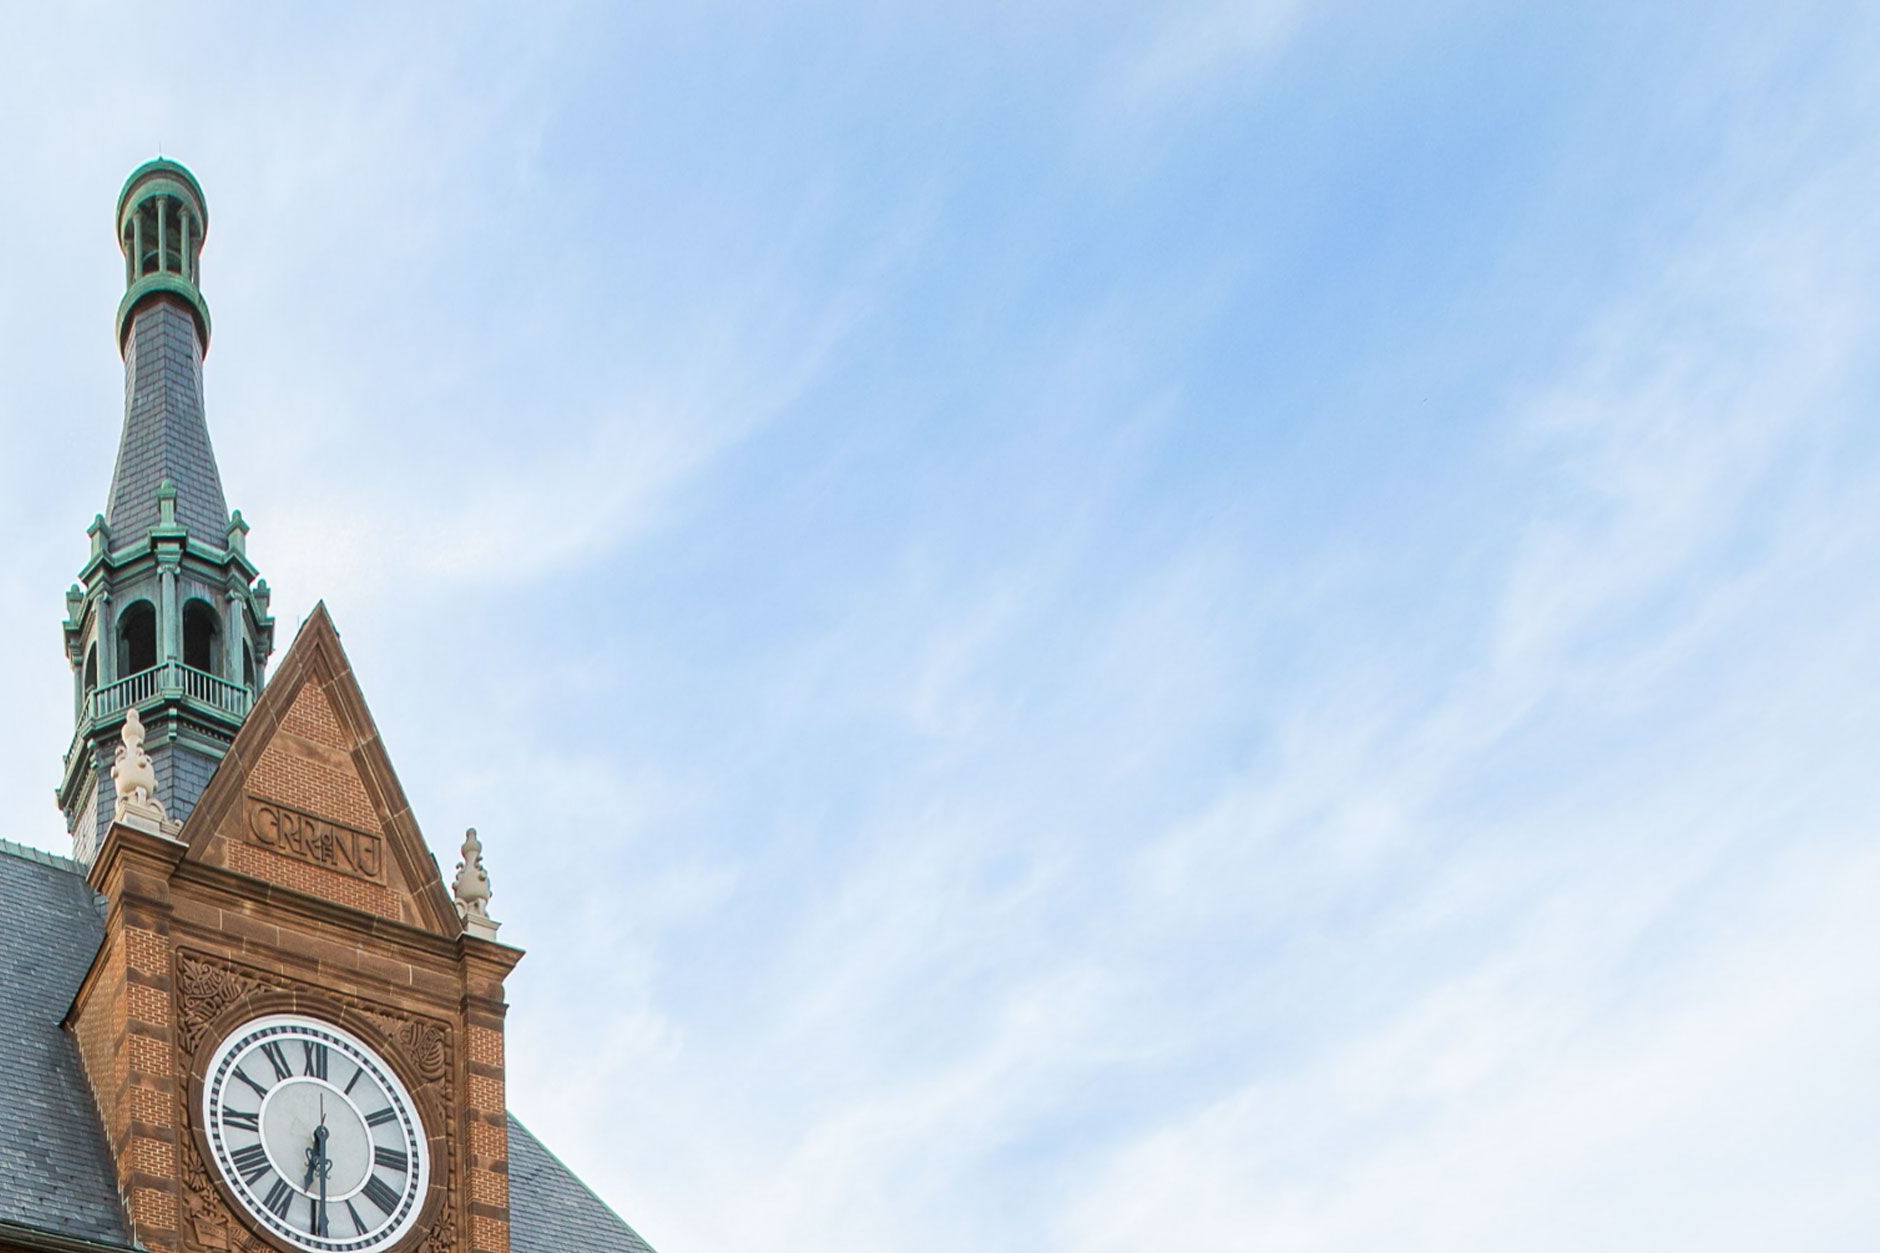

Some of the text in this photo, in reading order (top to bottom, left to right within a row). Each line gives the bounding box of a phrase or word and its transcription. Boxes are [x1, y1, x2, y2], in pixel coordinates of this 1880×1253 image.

[260, 1041, 293, 1082] XI
[303, 1041, 328, 1081] XII
[232, 1065, 268, 1100] X
[223, 1105, 259, 1133] IX
[365, 1107, 397, 1127] II
[230, 1143, 272, 1186] VIII
[374, 1146, 408, 1173] III
[345, 1200, 370, 1236] V
